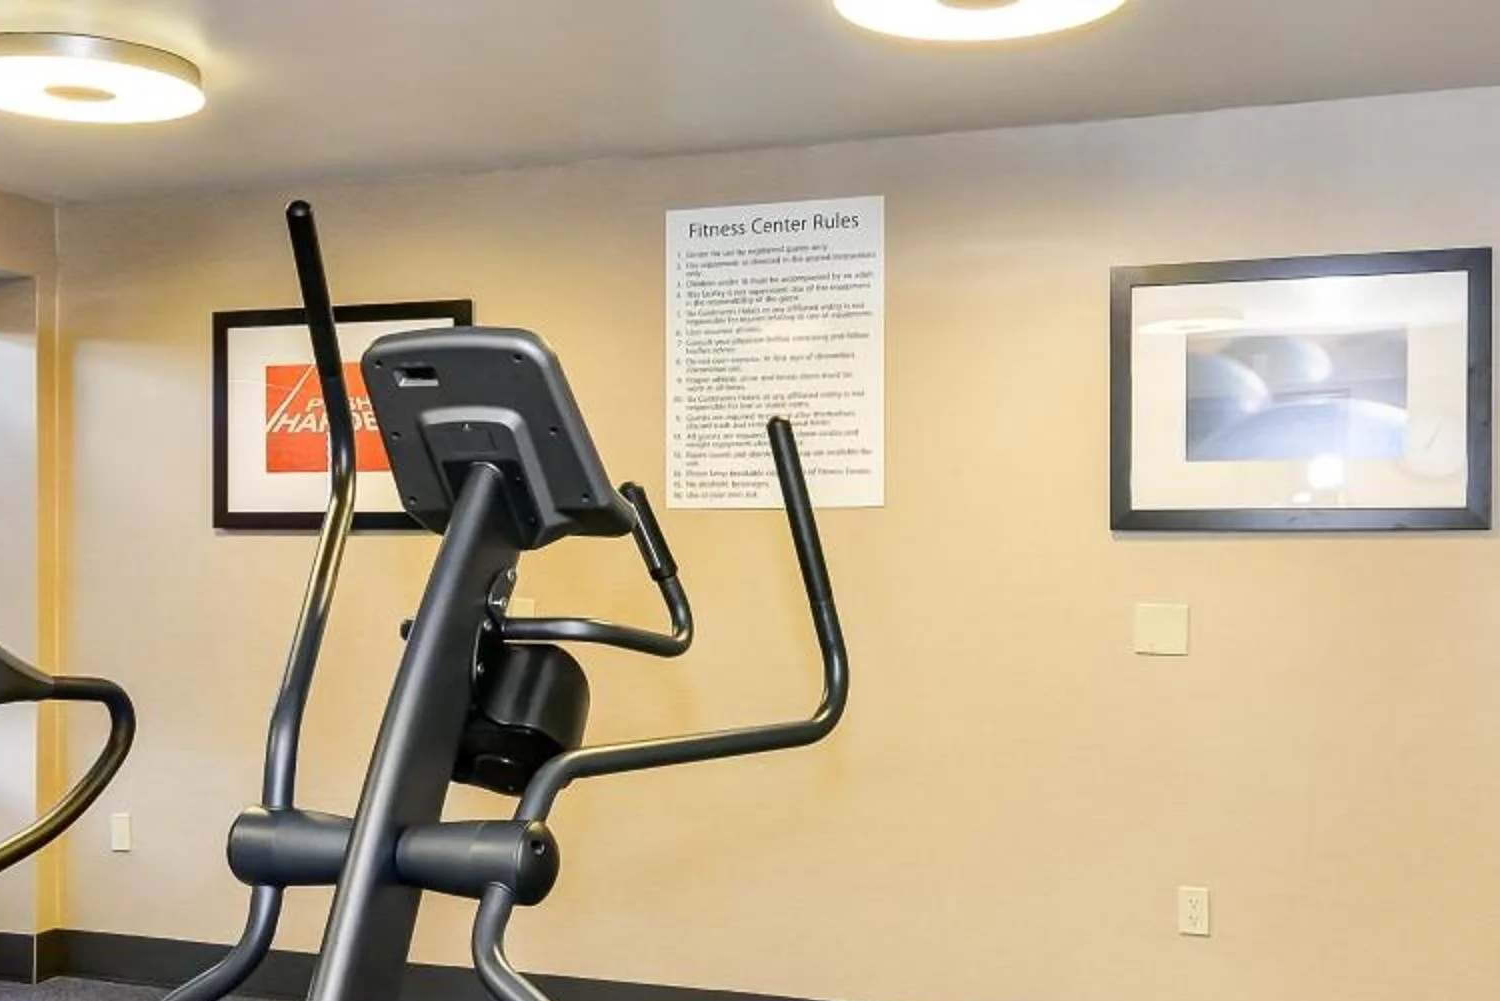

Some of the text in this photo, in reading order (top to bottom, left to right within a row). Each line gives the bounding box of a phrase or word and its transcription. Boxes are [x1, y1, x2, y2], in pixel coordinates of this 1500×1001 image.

[688, 211, 860, 238] Fitness Center Rules
[305, 396, 373, 412] PSH
